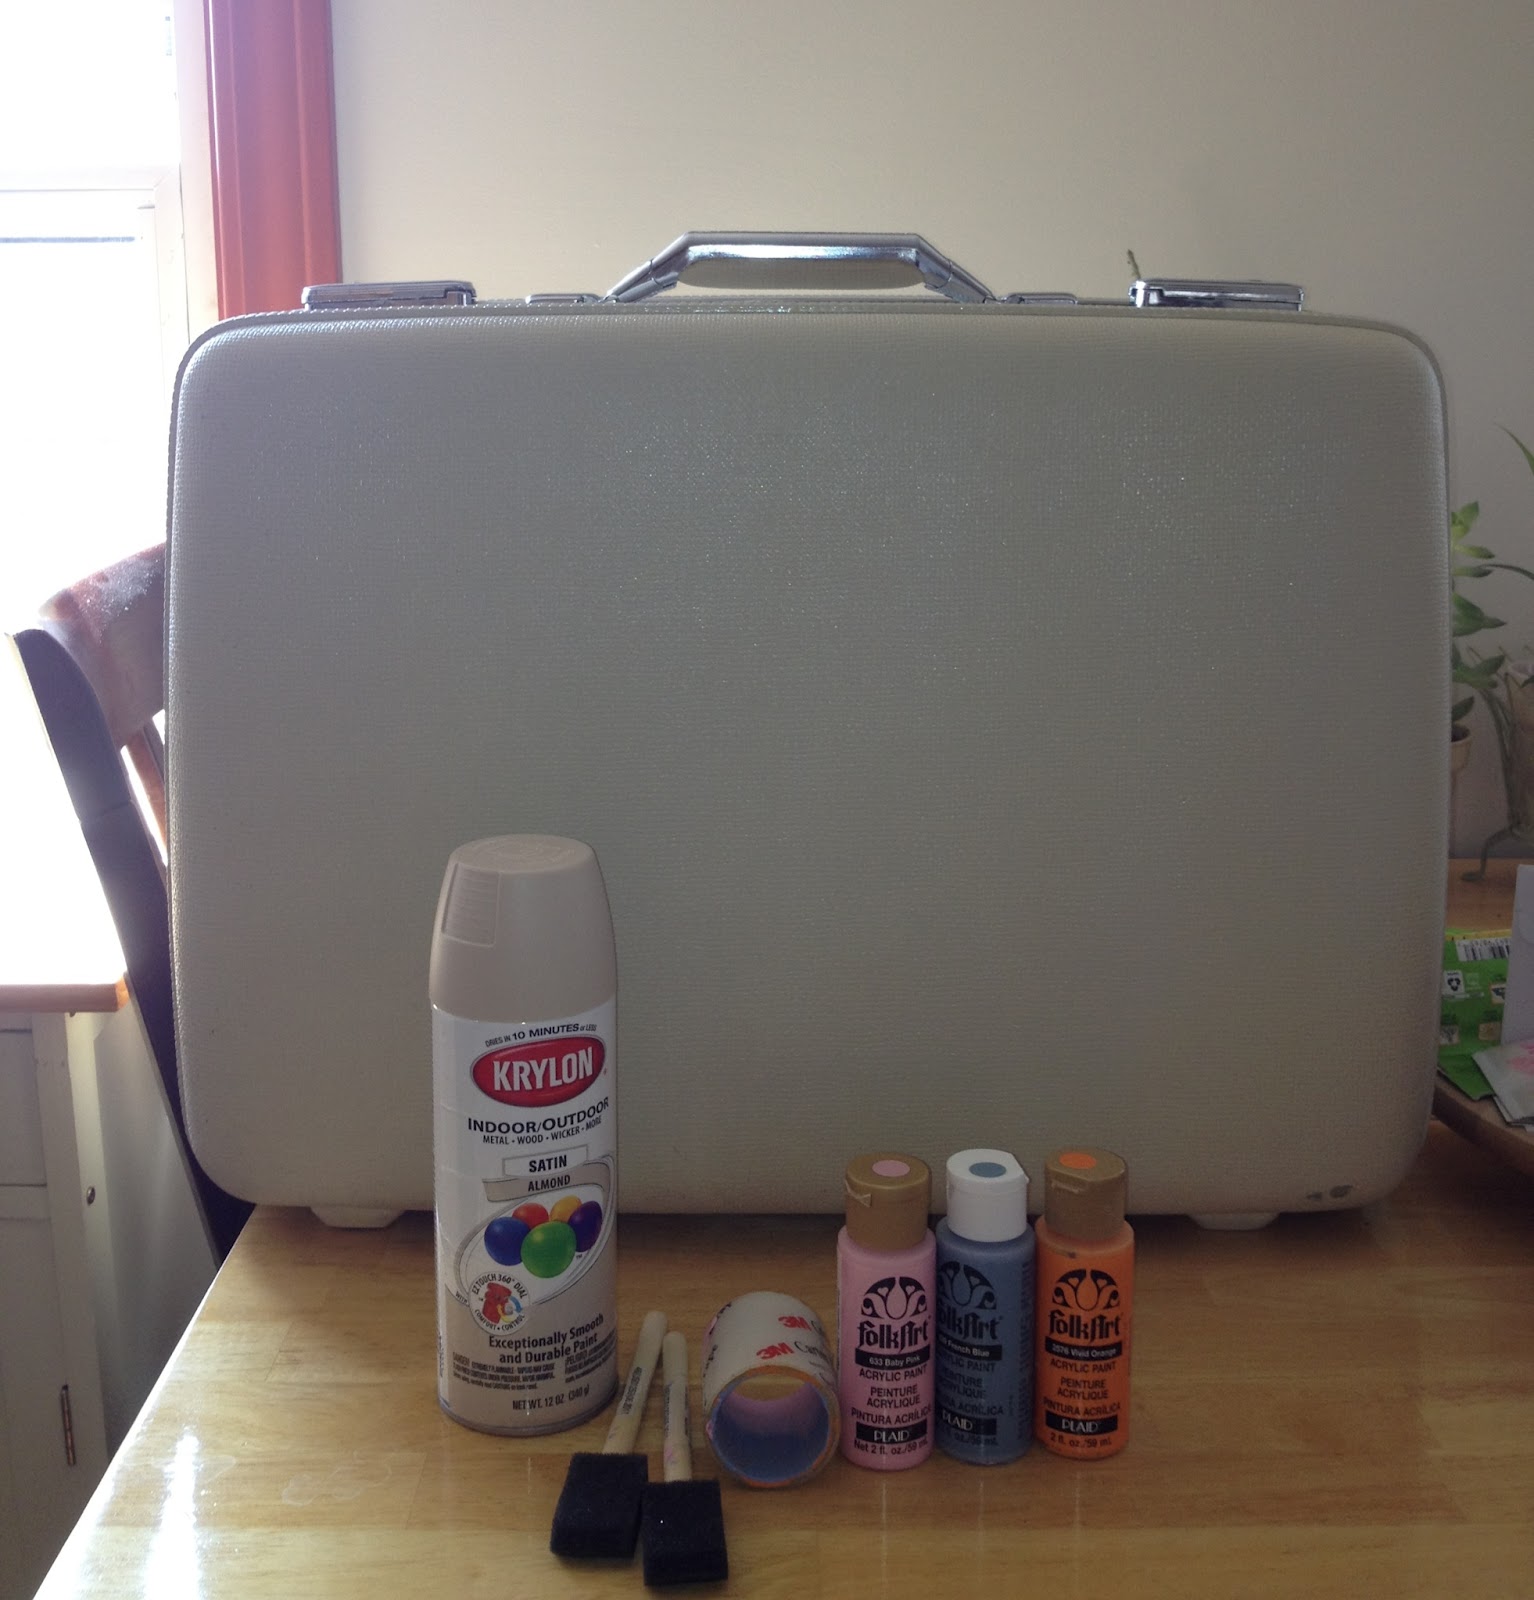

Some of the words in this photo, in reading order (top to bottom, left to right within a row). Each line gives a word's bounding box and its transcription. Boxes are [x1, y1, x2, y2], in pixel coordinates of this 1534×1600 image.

[485, 1036, 503, 1048] DRIES
[512, 1032, 525, 1040] 10
[529, 1024, 579, 1038] MINUTES
[493, 1047, 593, 1092] KRYLON
[468, 1097, 609, 1134] INDOOR/OUTDOOR
[483, 1135, 509, 1145] METAL
[517, 1135, 543, 1144] WOOD
[551, 1126, 580, 1140] WICKER
[586, 1116, 602, 1130] MORE
[529, 1155, 567, 1173] SATIN
[528, 1175, 571, 1192] ALMOND
[514, 1282, 527, 1298] DIAL
[474, 1309, 496, 1330] COMFORT
[502, 1314, 525, 1331] CONTROL
[778, 1316, 812, 1331] 3M
[489, 1332, 567, 1351] Exceptionally
[570, 1314, 604, 1340] Smooth
[500, 1353, 521, 1364] and
[525, 1346, 570, 1363] Durable
[573, 1334, 597, 1353] Paint
[756, 1342, 794, 1360] 3M
[972, 1348, 990, 1357] Blue
[1071, 1348, 1090, 1358] Vivid
[1091, 1347, 1117, 1358] Orange
[869, 1357, 883, 1366] 633
[885, 1357, 904, 1367] Baby
[906, 1354, 920, 1364] Pink
[967, 1360, 996, 1372] PAINT
[1050, 1358, 1090, 1373] ACRYLIC
[1092, 1360, 1116, 1373] PAINT
[859, 1368, 901, 1381] ACRYLIC
[904, 1364, 927, 1380] PAINT
[1060, 1376, 1106, 1389] PEINTURE
[870, 1384, 917, 1398] PEINTURE
[1057, 1388, 1109, 1400] ACRYLIQUE
[513, 1399, 527, 1410] NET
[545, 1397, 553, 1407] 12
[555, 1394, 564, 1405] OZ
[867, 1394, 920, 1409] ACRYLIQUE
[1043, 1396, 1080, 1415] PINTURA
[851, 1407, 892, 1425] PINTURA
[942, 1410, 973, 1431] PLAID
[1061, 1418, 1098, 1433] PLAID
[874, 1430, 910, 1442] PLAID
[1050, 1432, 1056, 1441] 2
[854, 1439, 868, 1453] Net
[871, 1444, 876, 1454] 2
